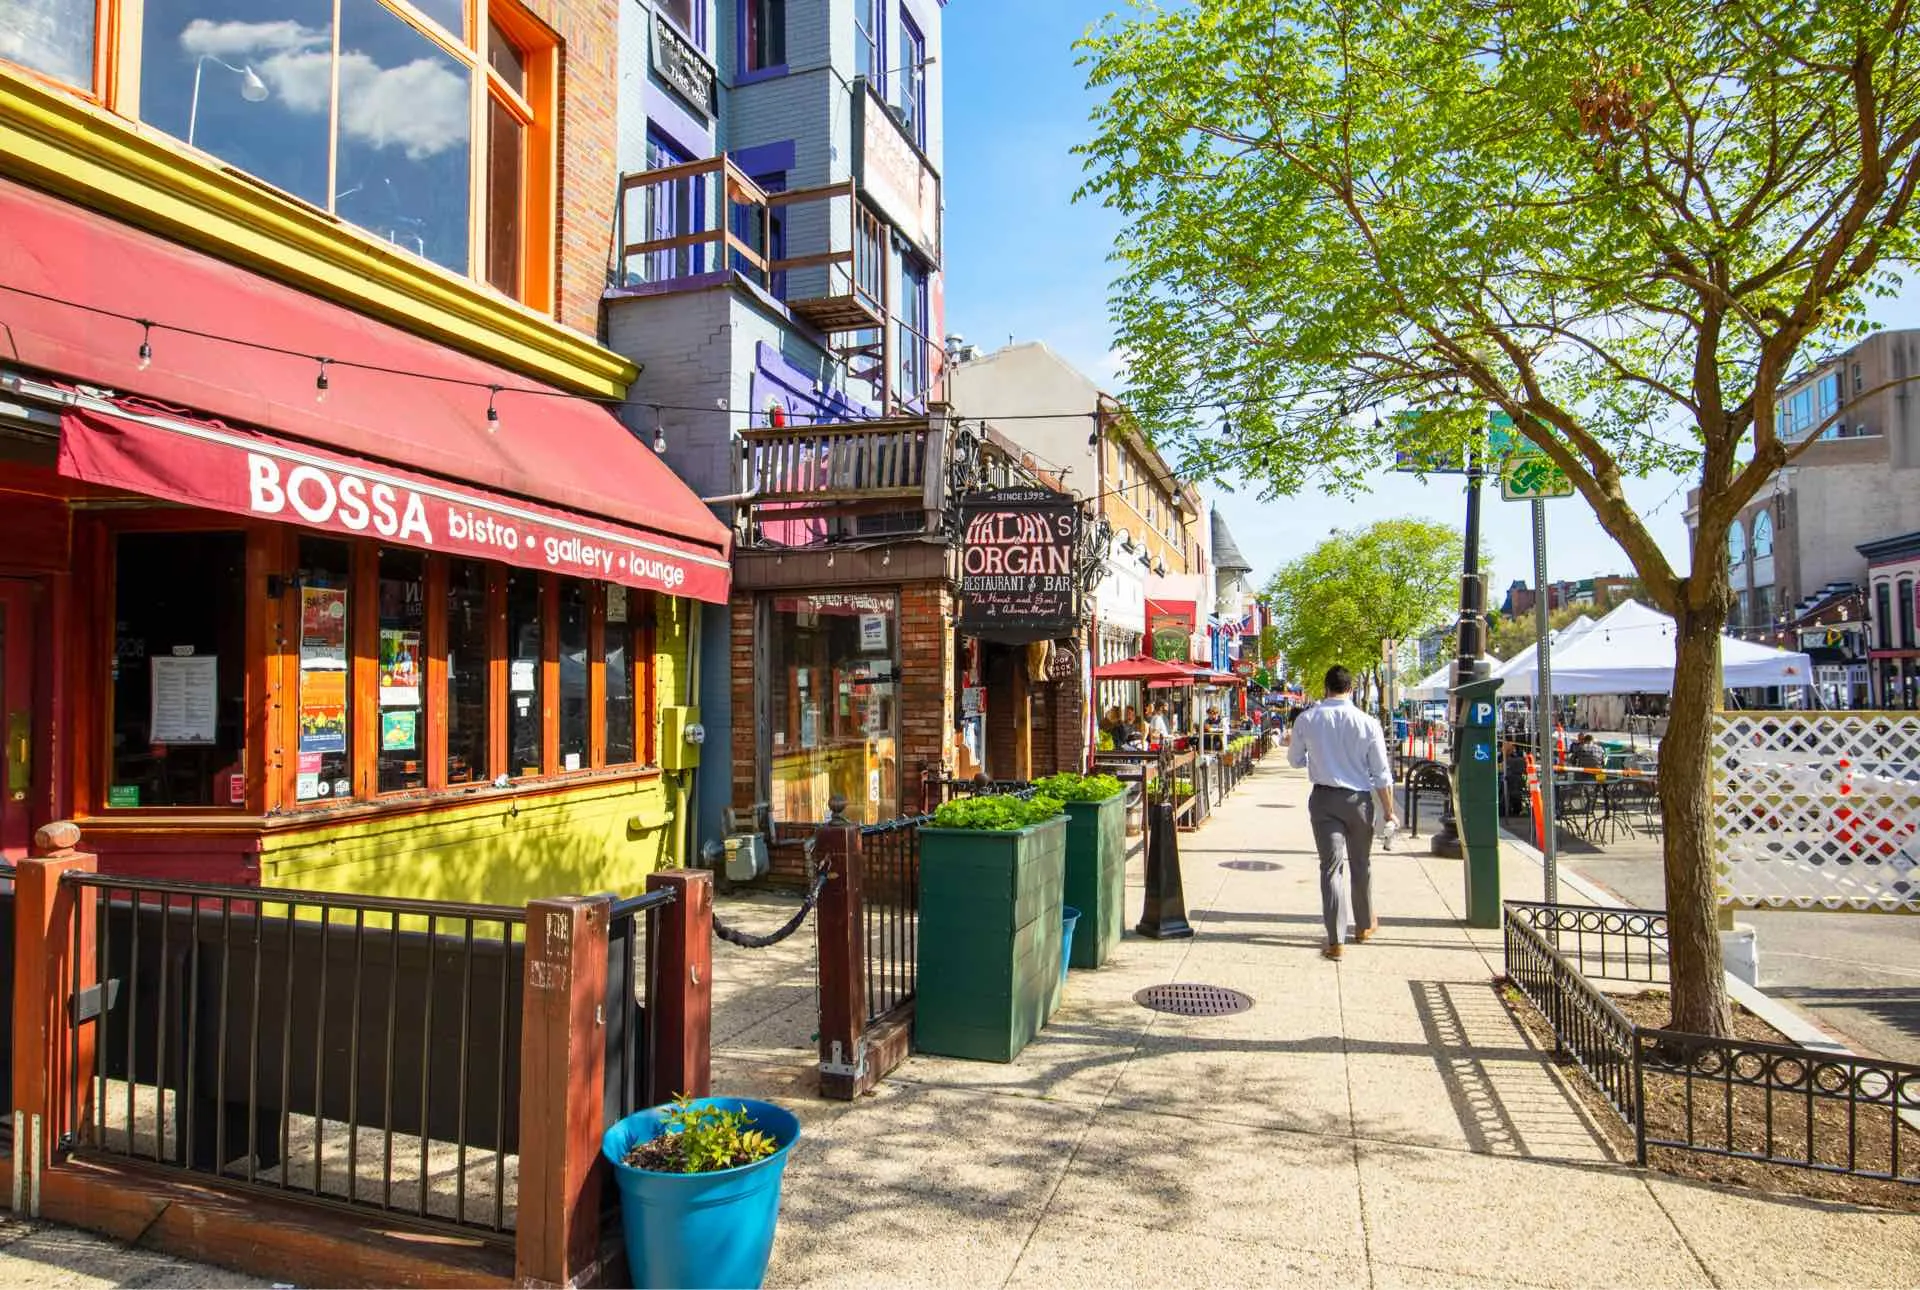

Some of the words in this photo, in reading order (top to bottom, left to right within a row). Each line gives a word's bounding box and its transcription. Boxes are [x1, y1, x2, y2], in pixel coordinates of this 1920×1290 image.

[670, 64, 690, 91] THIS
[691, 86, 708, 109] WAY
[997, 492, 1022, 501] SINCE
[1023, 491, 1045, 501] 1992
[246, 453, 433, 545] BOSSA
[448, 509, 519, 551] bistro
[543, 535, 614, 575] gallery
[628, 553, 685, 588] lounge
[964, 545, 1072, 575] ORGAN
[963, 576, 1025, 592] RESTAURANT
[1043, 577, 1072, 592] BAR
[1015, 593, 1032, 603] and
[1477, 703, 1492, 724] P
